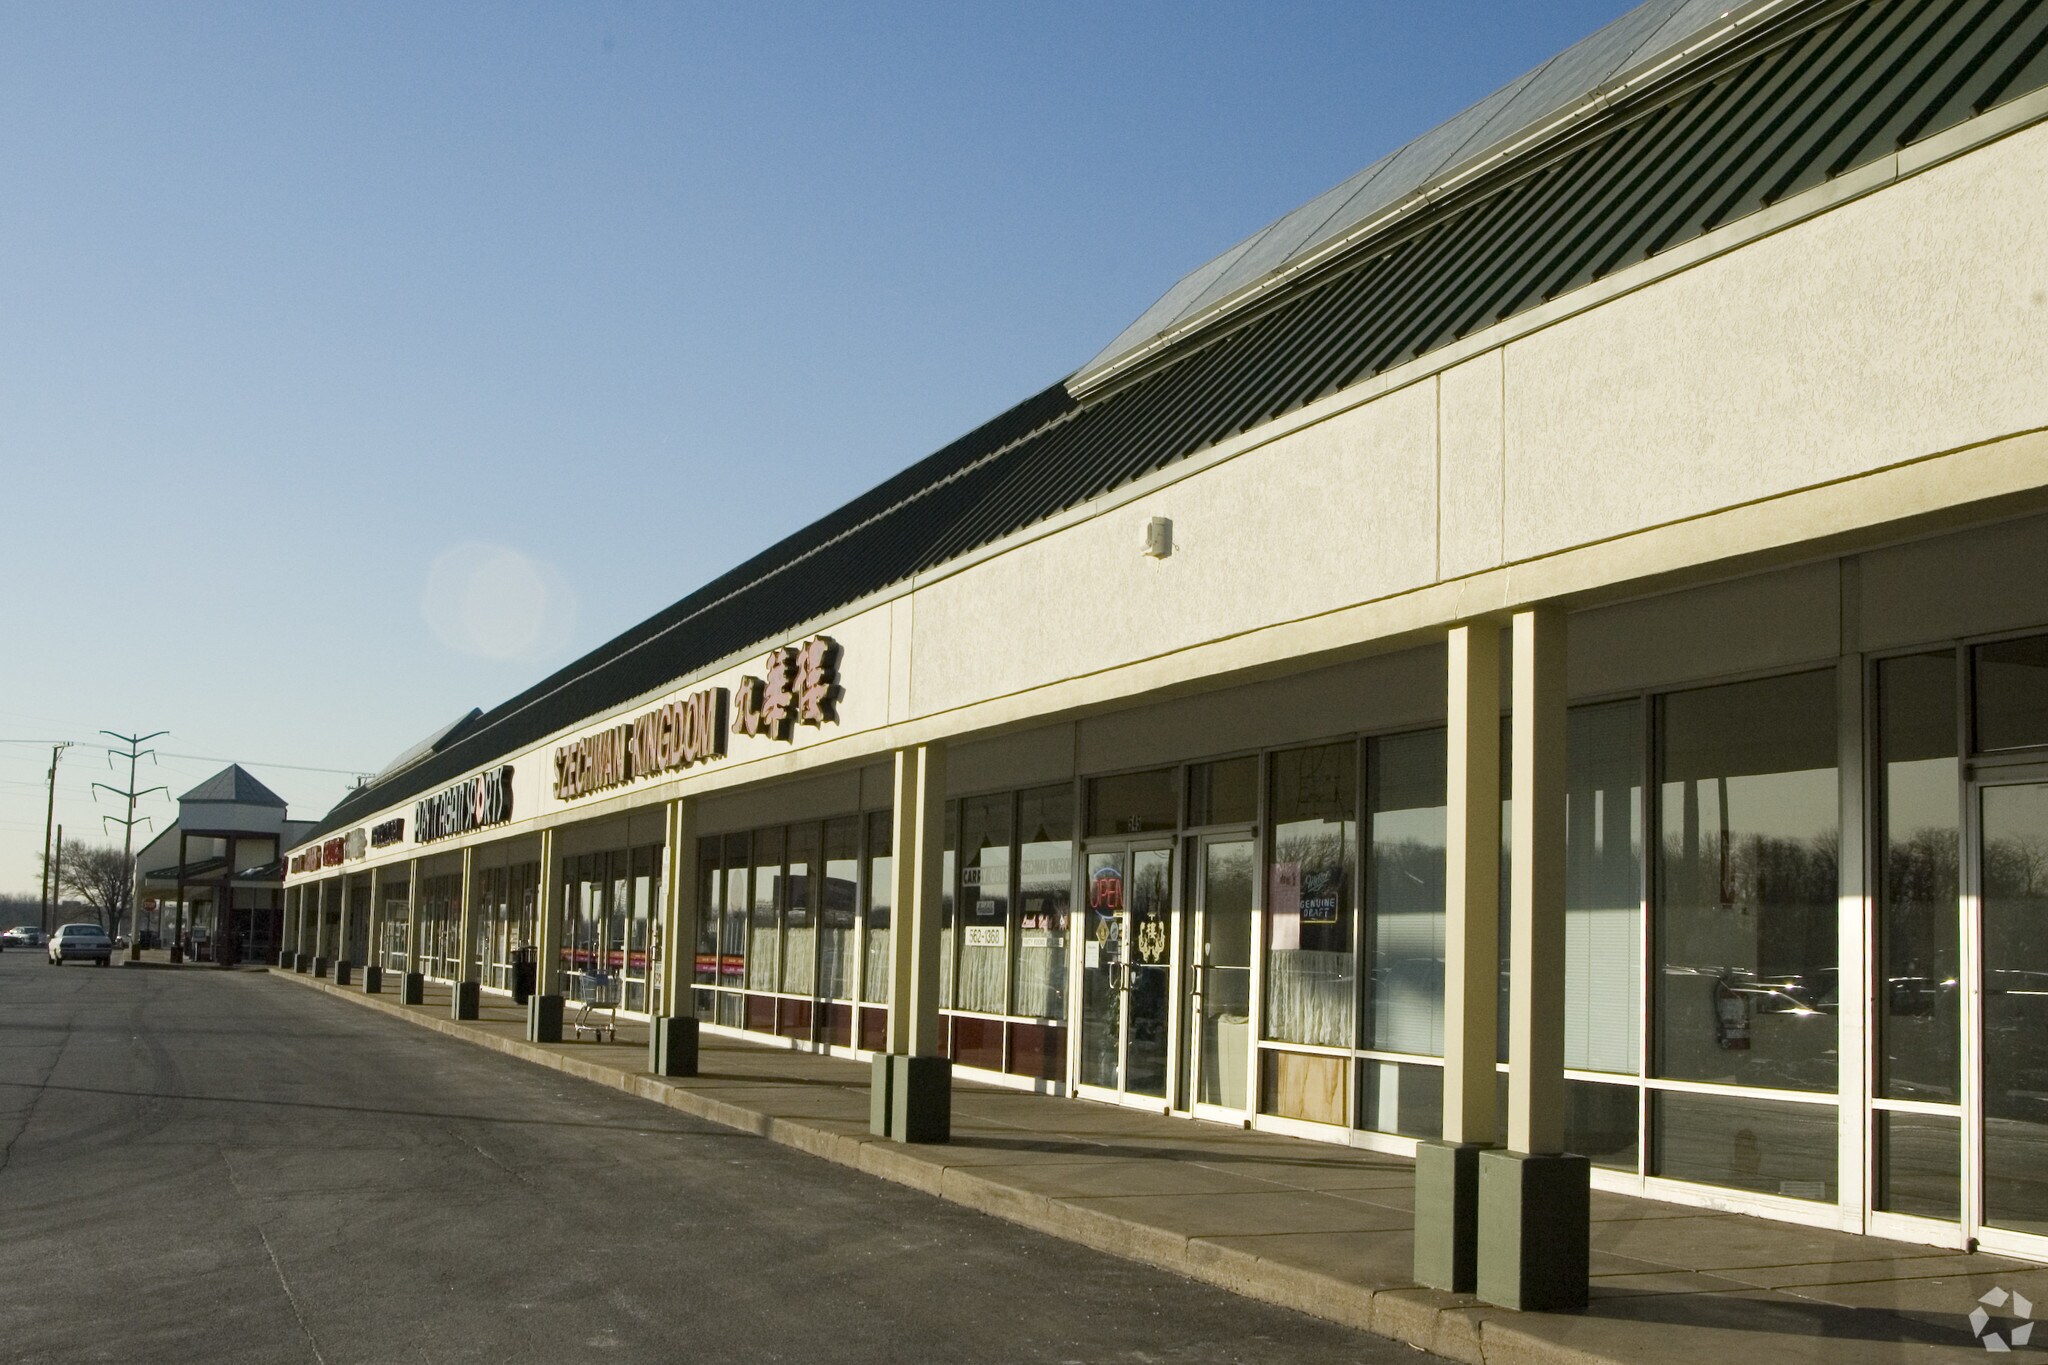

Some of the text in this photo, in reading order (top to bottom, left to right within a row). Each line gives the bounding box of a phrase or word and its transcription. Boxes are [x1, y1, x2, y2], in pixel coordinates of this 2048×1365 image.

[553, 687, 726, 800] SZECHWAN KINGDOM
[466, 766, 512, 829] SPORTS
[1090, 878, 1124, 908] OPEN
[1300, 898, 1335, 909] GENUINE
[1304, 908, 1330, 918] DRAFT
[969, 929, 1000, 944] 562-1368
